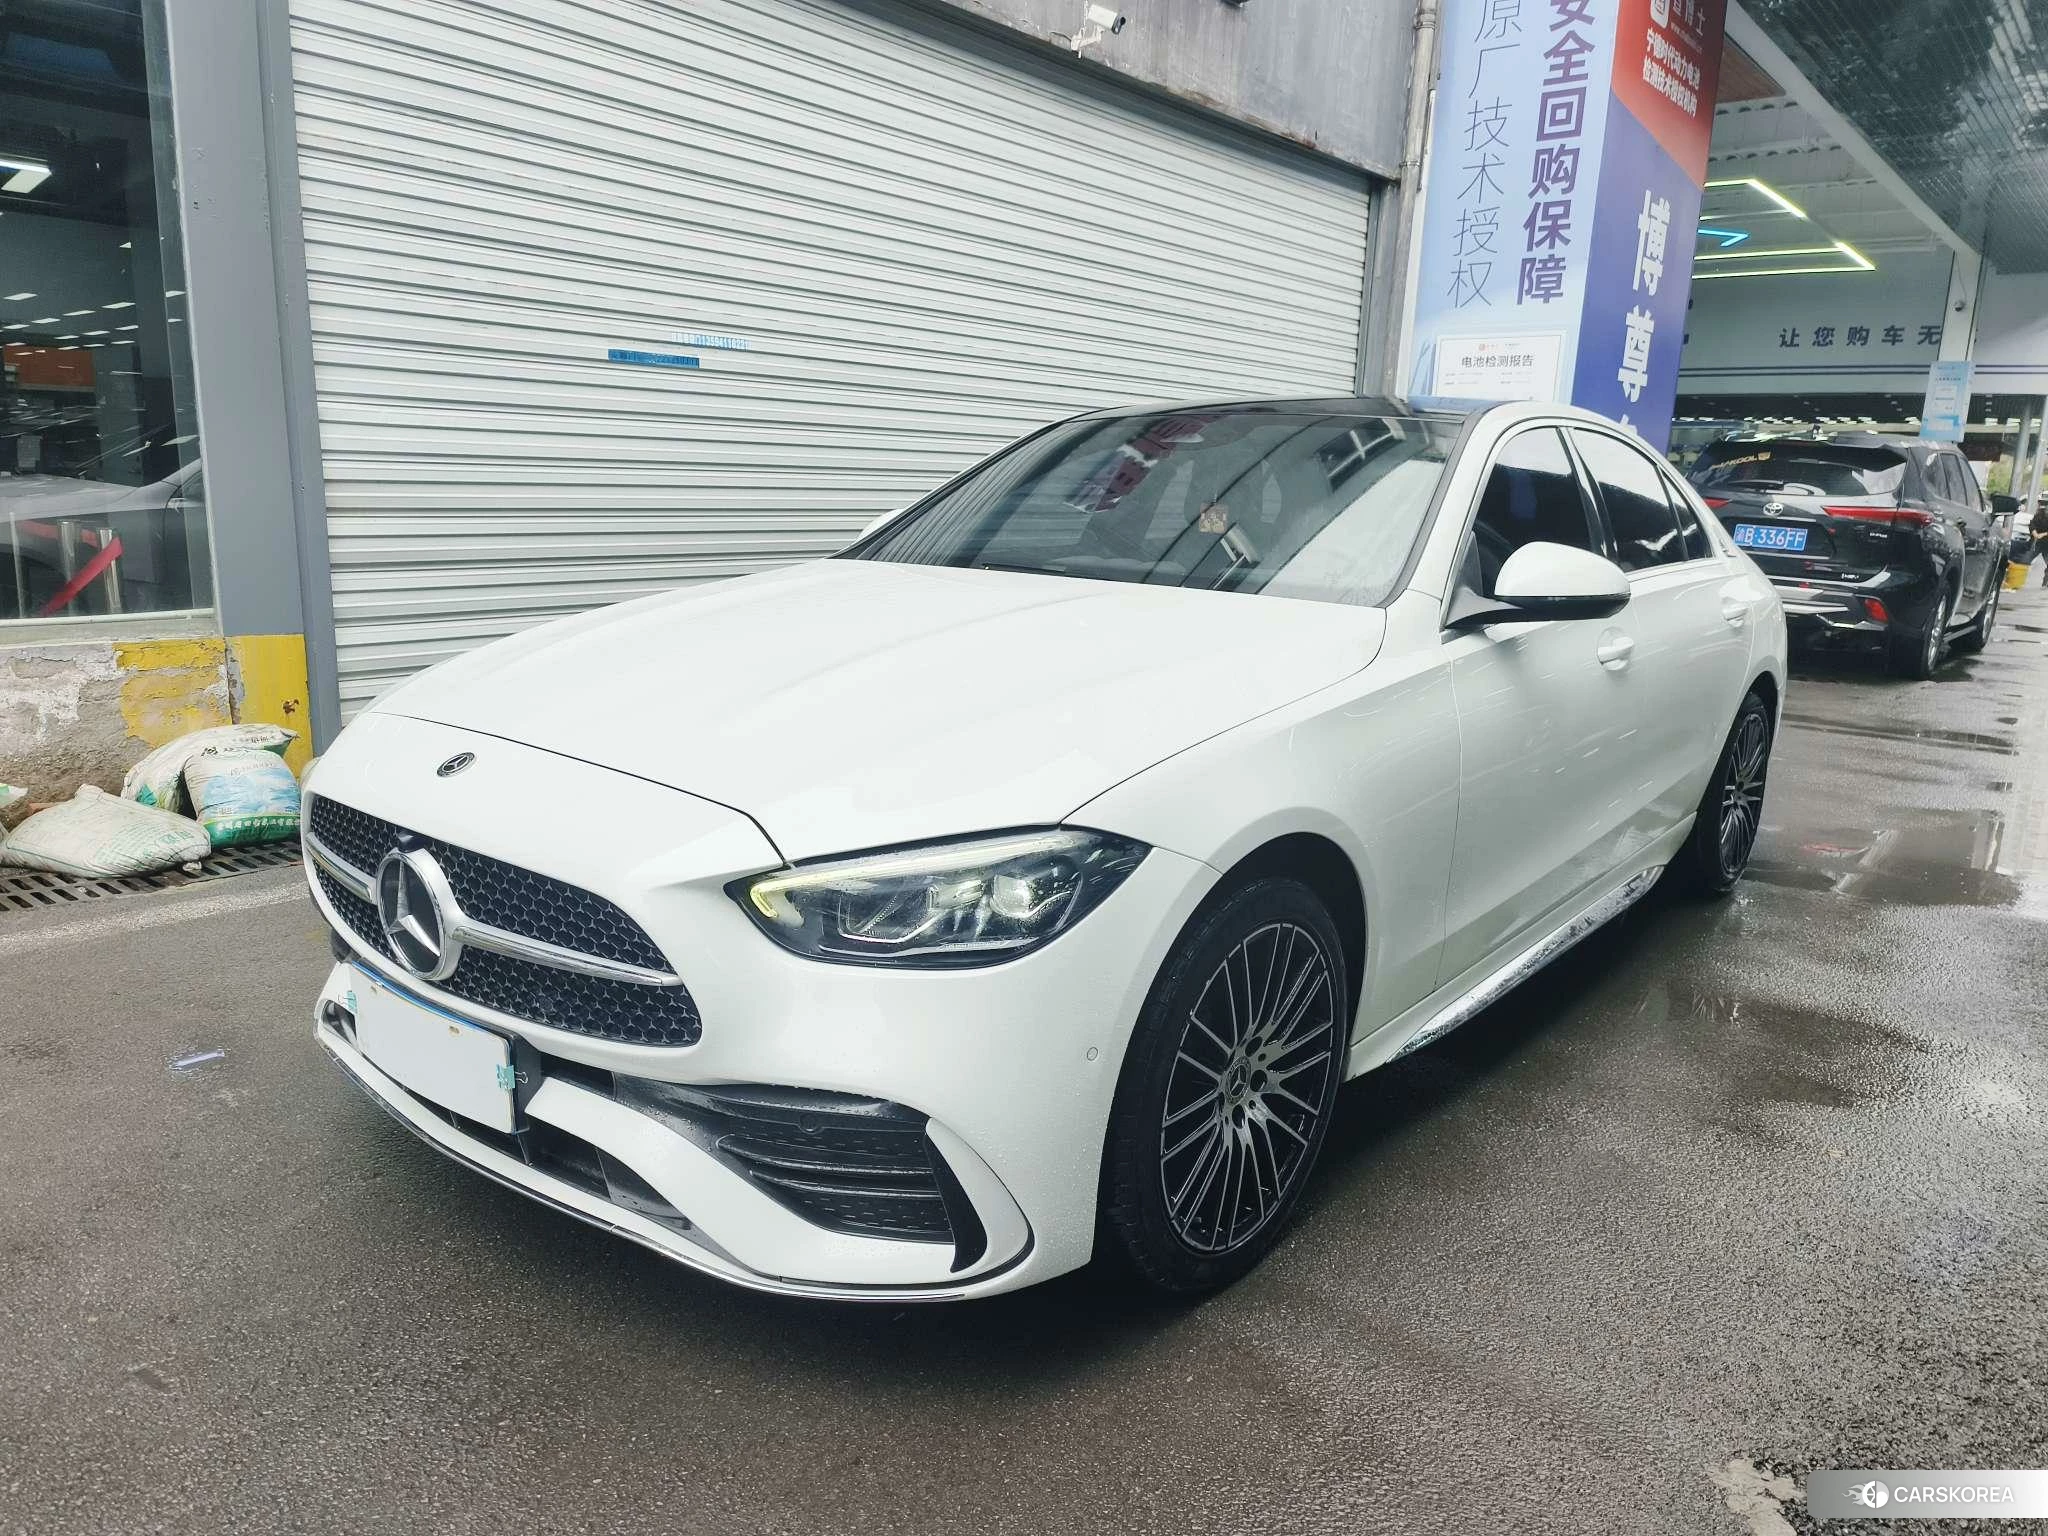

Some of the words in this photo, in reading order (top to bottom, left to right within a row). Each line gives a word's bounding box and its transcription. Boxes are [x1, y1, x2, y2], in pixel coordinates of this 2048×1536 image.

[1447, 0, 1522, 309] 原厂技术授权
[1516, 0, 1596, 306] 安全回购保障
[1461, 354, 1534, 368] 电池检测报告
[1617, 189, 1671, 434] 博尊
